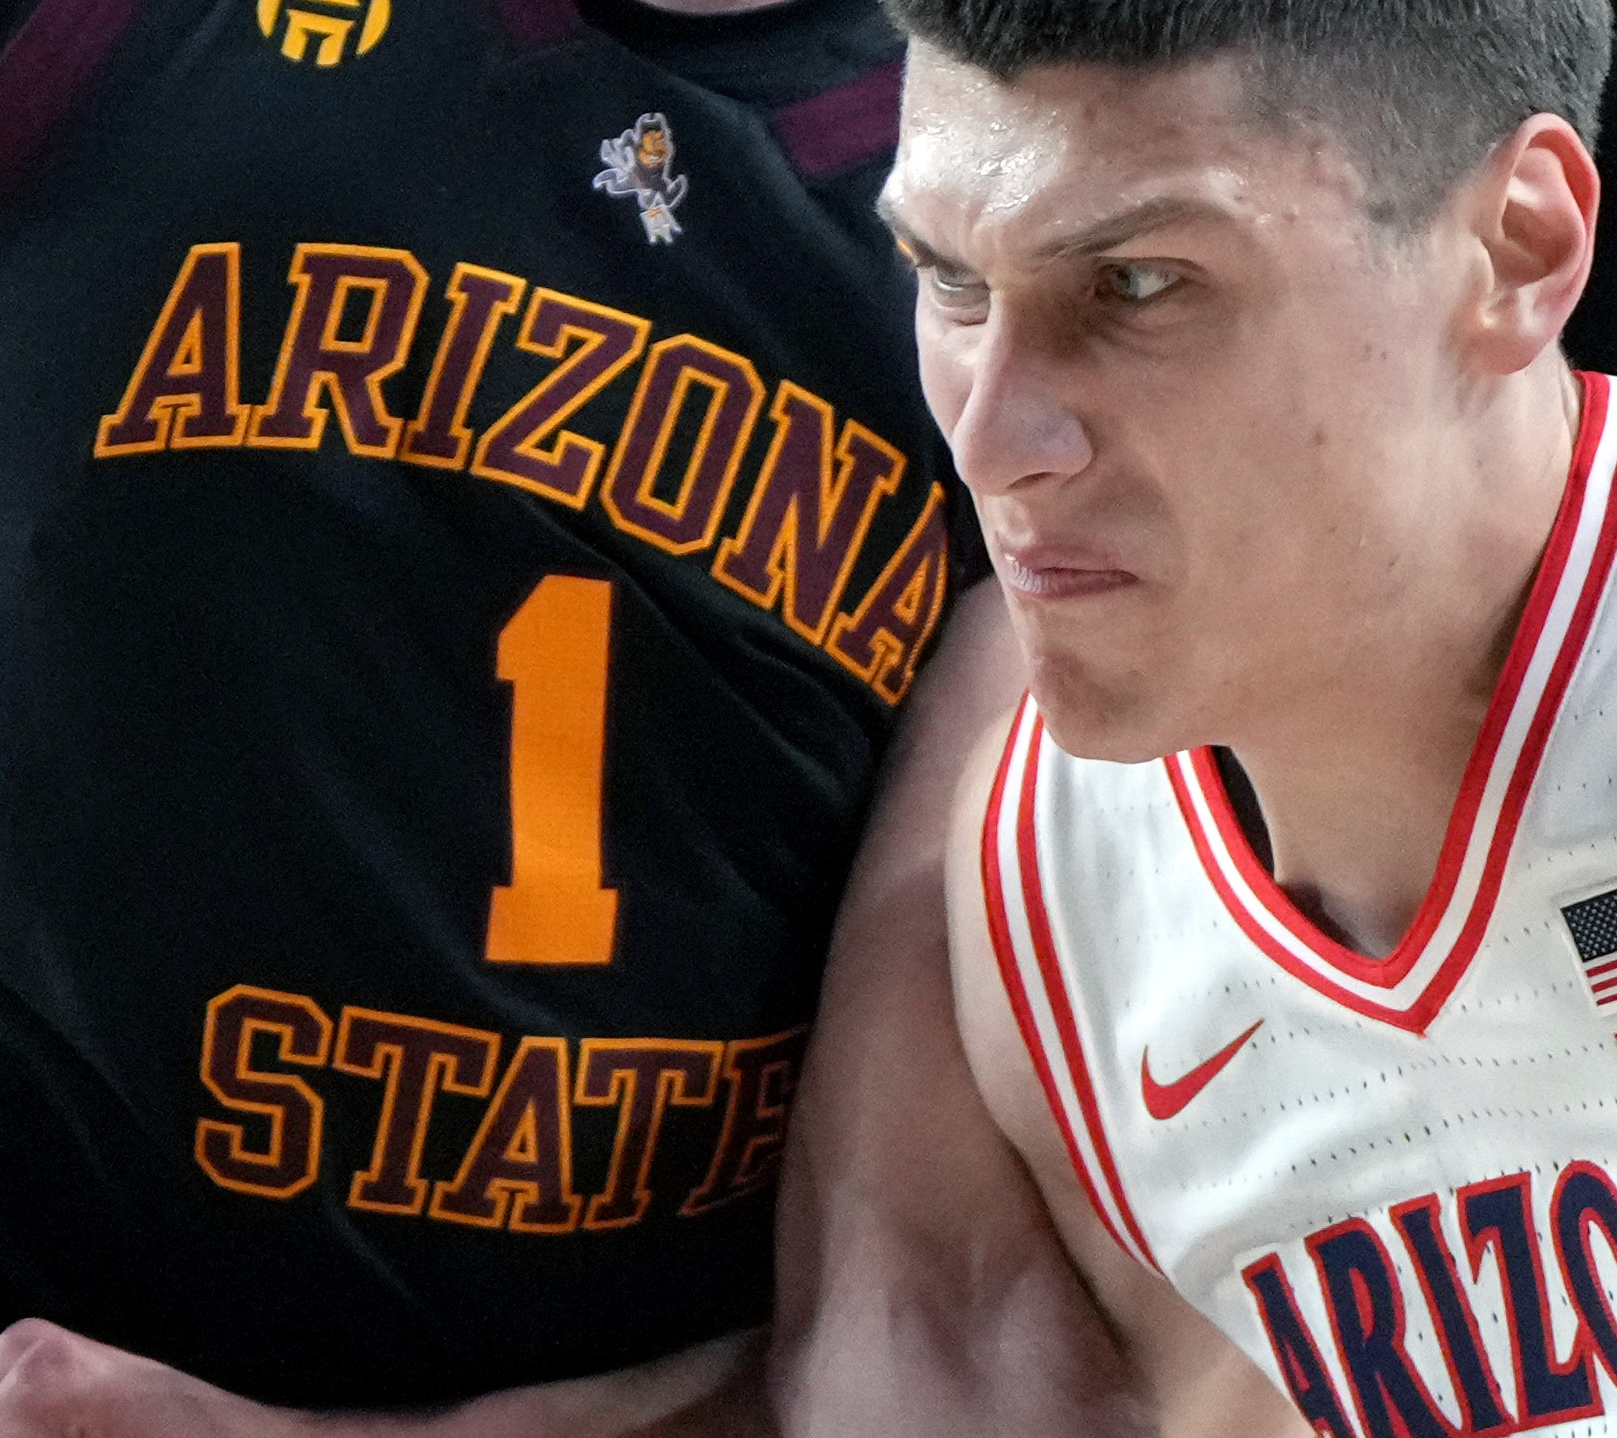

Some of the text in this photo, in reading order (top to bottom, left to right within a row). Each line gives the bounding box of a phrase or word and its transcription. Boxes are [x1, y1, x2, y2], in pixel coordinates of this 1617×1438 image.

[94, 240, 949, 706] ARIZONA
[483, 573, 620, 964] 1
[194, 983, 816, 1235] STATE
